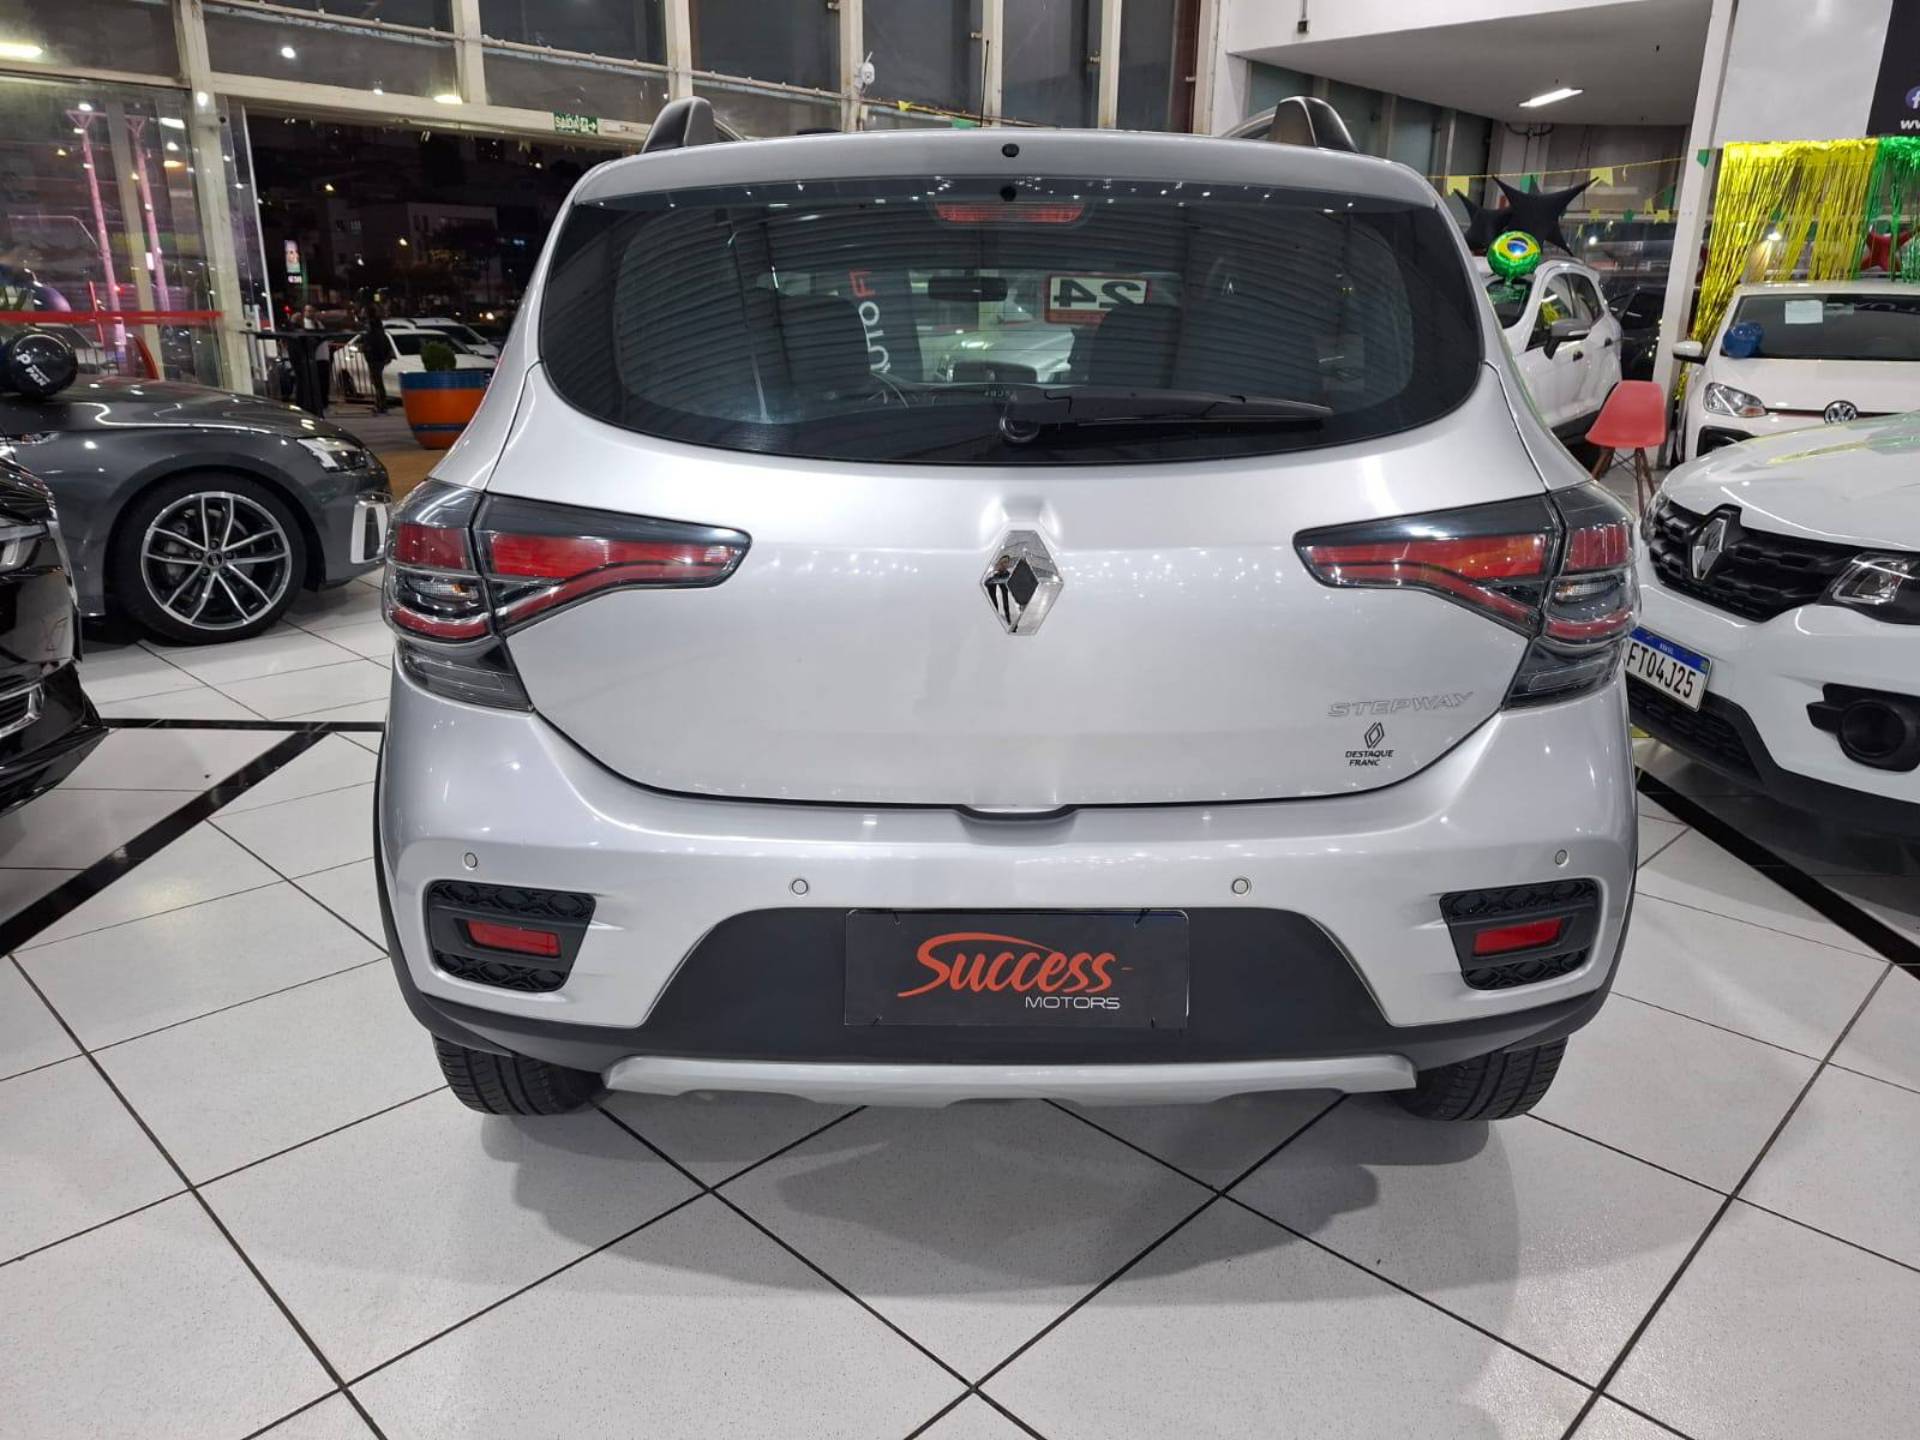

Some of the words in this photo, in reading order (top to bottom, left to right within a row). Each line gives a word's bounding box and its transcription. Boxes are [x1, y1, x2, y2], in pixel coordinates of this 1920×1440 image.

[1328, 691, 1474, 717] STEPWAY
[1345, 749, 1394, 758] DESTAQUE
[898, 932, 1117, 998] Success
[1024, 995, 1121, 1010] MOTORS
